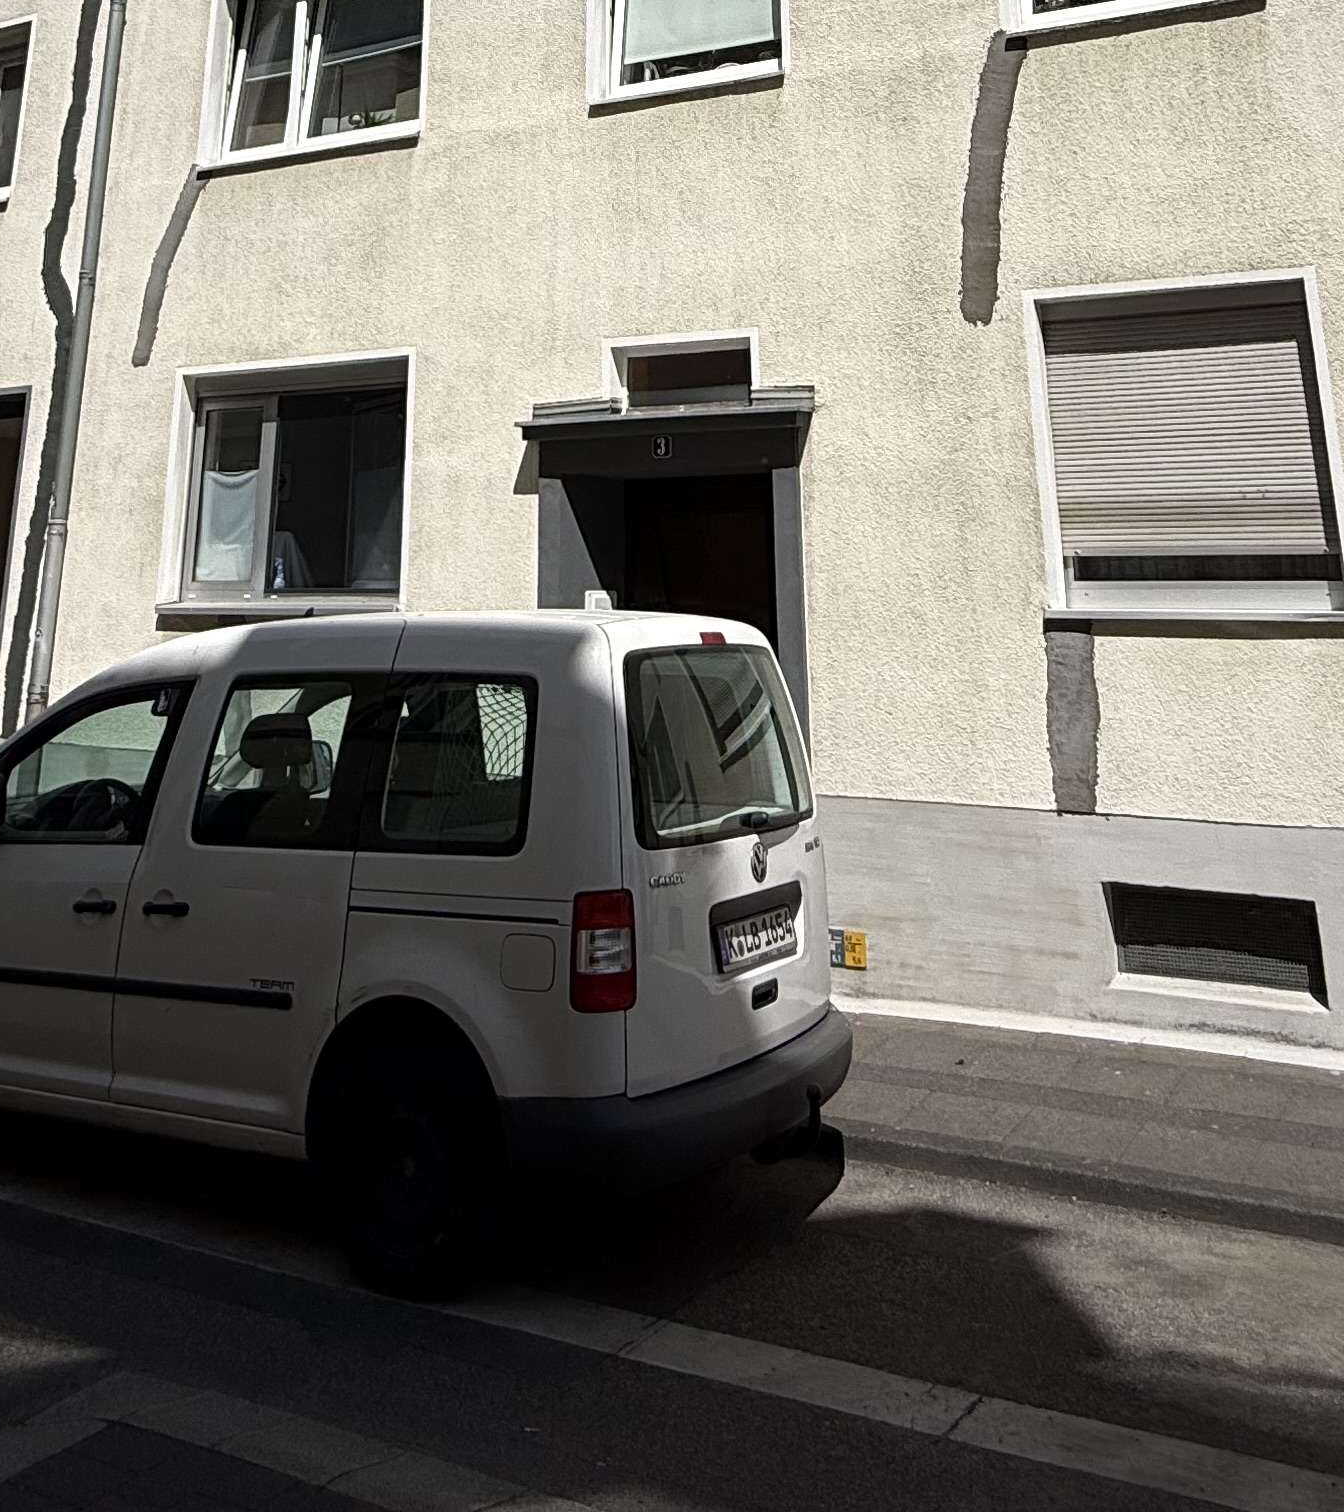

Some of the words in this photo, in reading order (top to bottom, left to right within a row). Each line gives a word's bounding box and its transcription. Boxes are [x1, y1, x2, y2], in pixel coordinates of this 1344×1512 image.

[656, 437, 666, 456] 3
[725, 928, 738, 959] K
[742, 921, 761, 953] LB
[761, 910, 793, 947] 1654
[248, 978, 295, 993] TEAM
